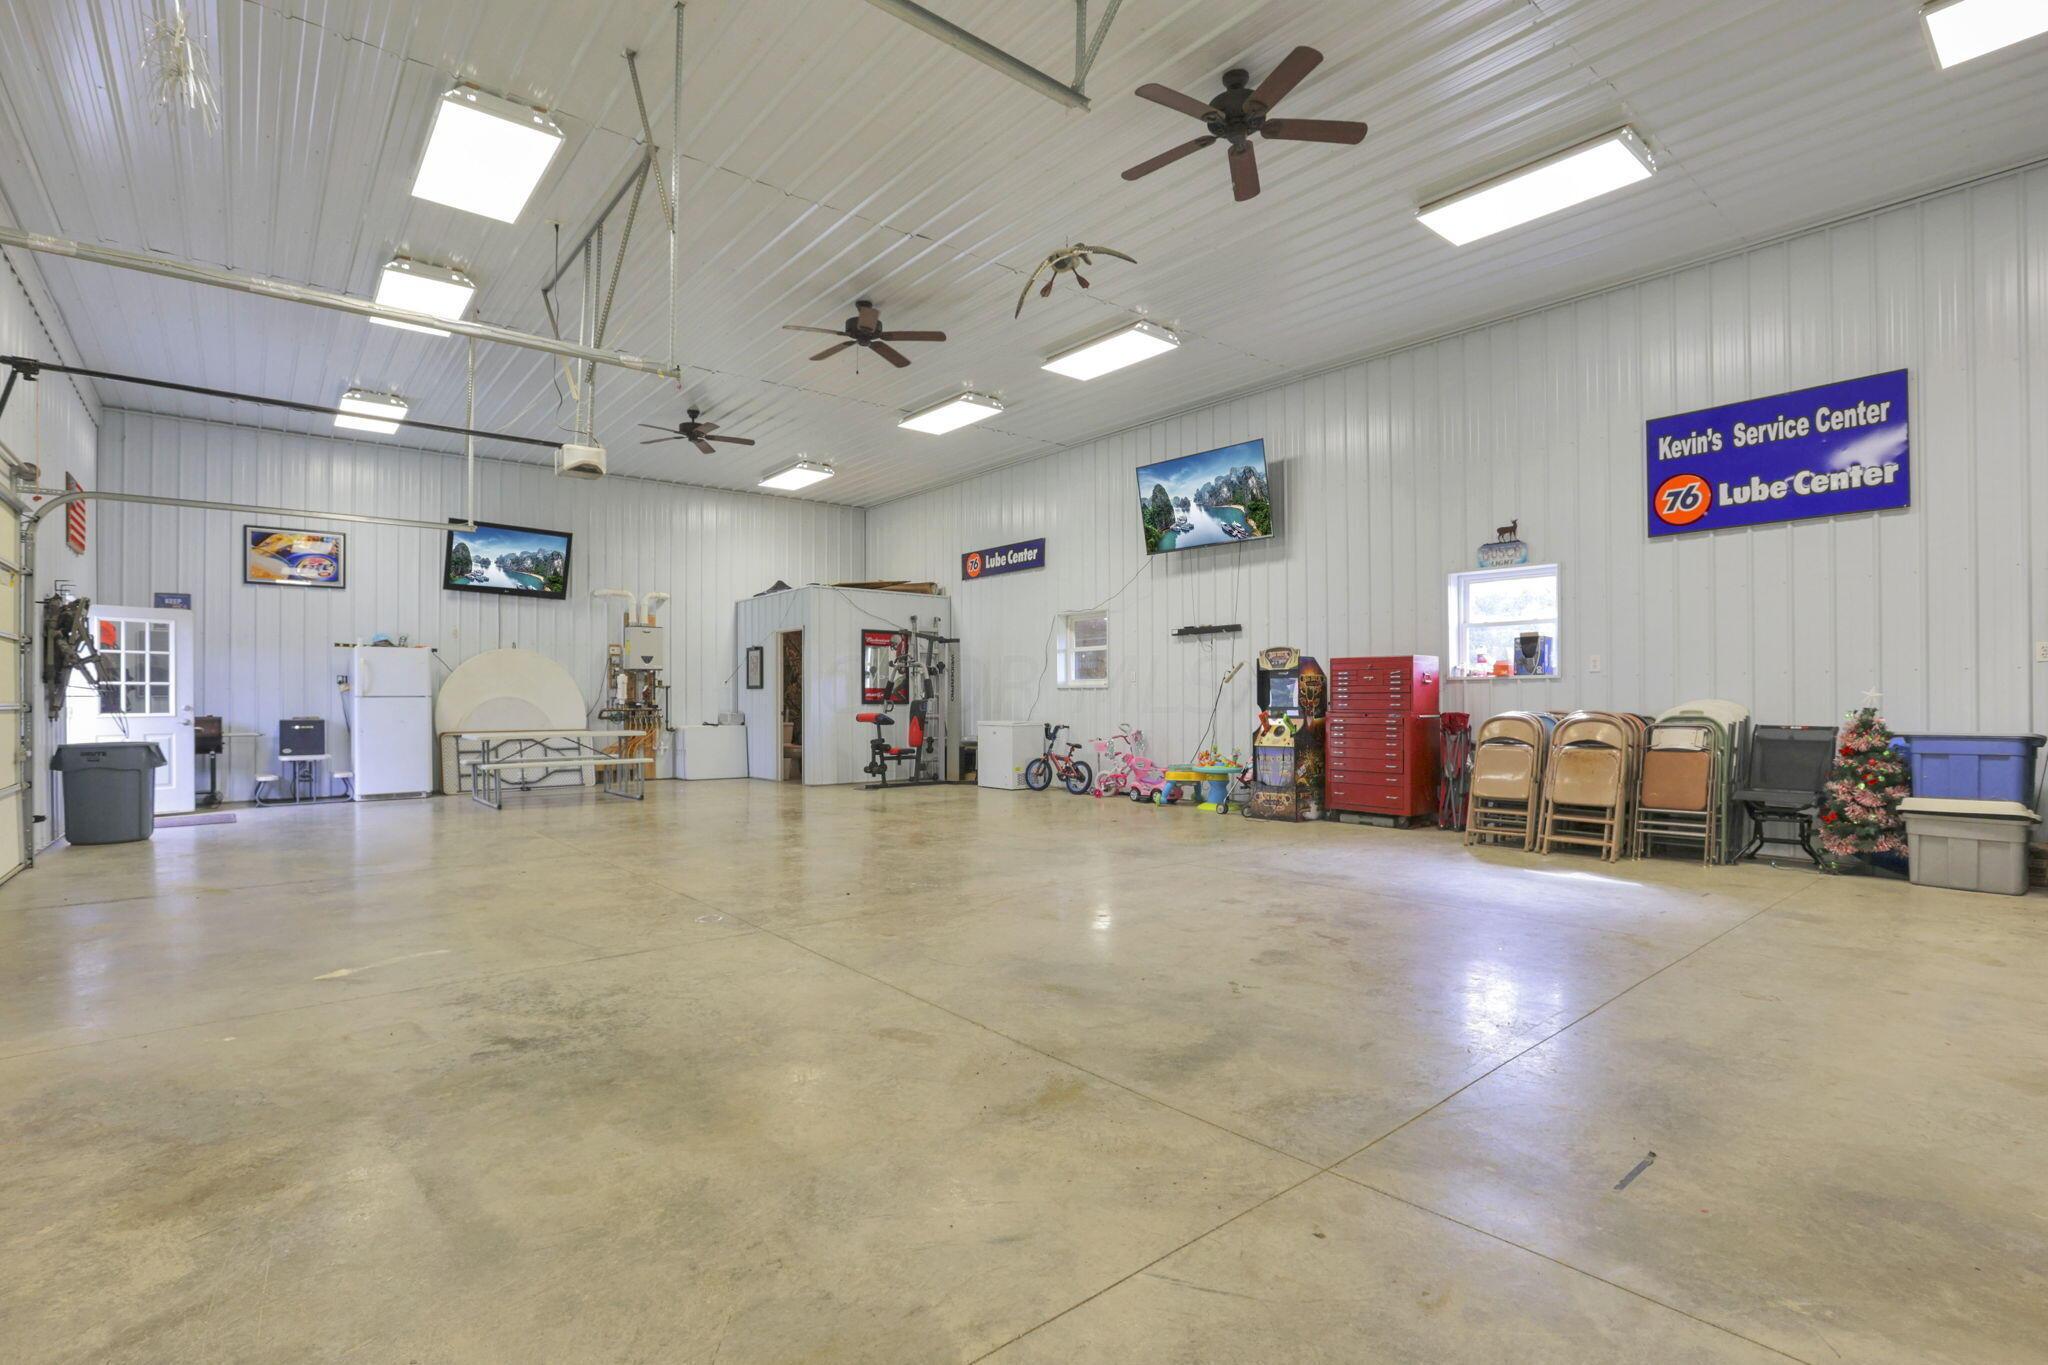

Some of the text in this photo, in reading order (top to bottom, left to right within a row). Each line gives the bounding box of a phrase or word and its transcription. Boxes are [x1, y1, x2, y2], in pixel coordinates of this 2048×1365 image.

[1658, 399, 1891, 460] Kevin's Service Center
[1661, 462, 1899, 515] 76 Lube Center
[985, 552, 1006, 569] Lube
[1007, 548, 1038, 565] Center
